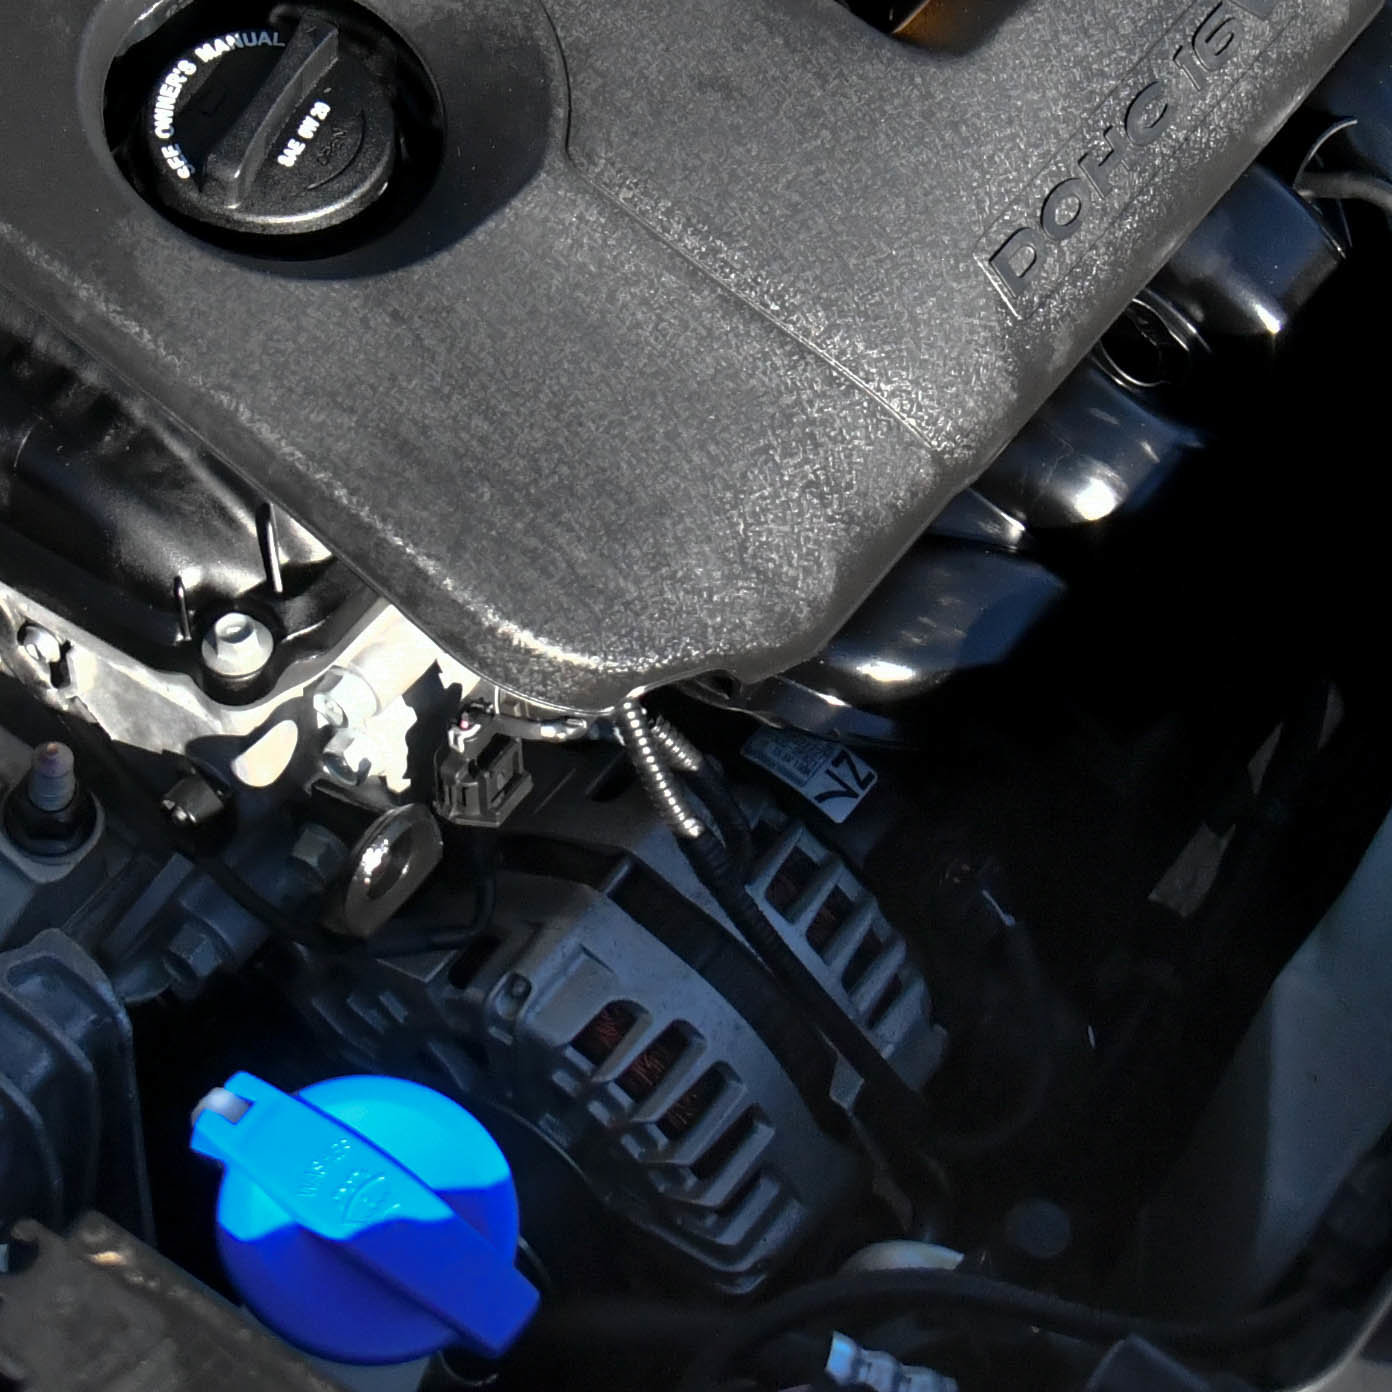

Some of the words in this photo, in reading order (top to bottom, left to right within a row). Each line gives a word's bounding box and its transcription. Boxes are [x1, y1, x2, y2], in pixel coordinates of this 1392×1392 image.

[194, 30, 286, 64] MANUAL
[153, 58, 198, 140] OWNER'S
[160, 142, 196, 180] SEE
[277, 138, 307, 168] SAE
[988, 81, 1176, 298] DOHC
